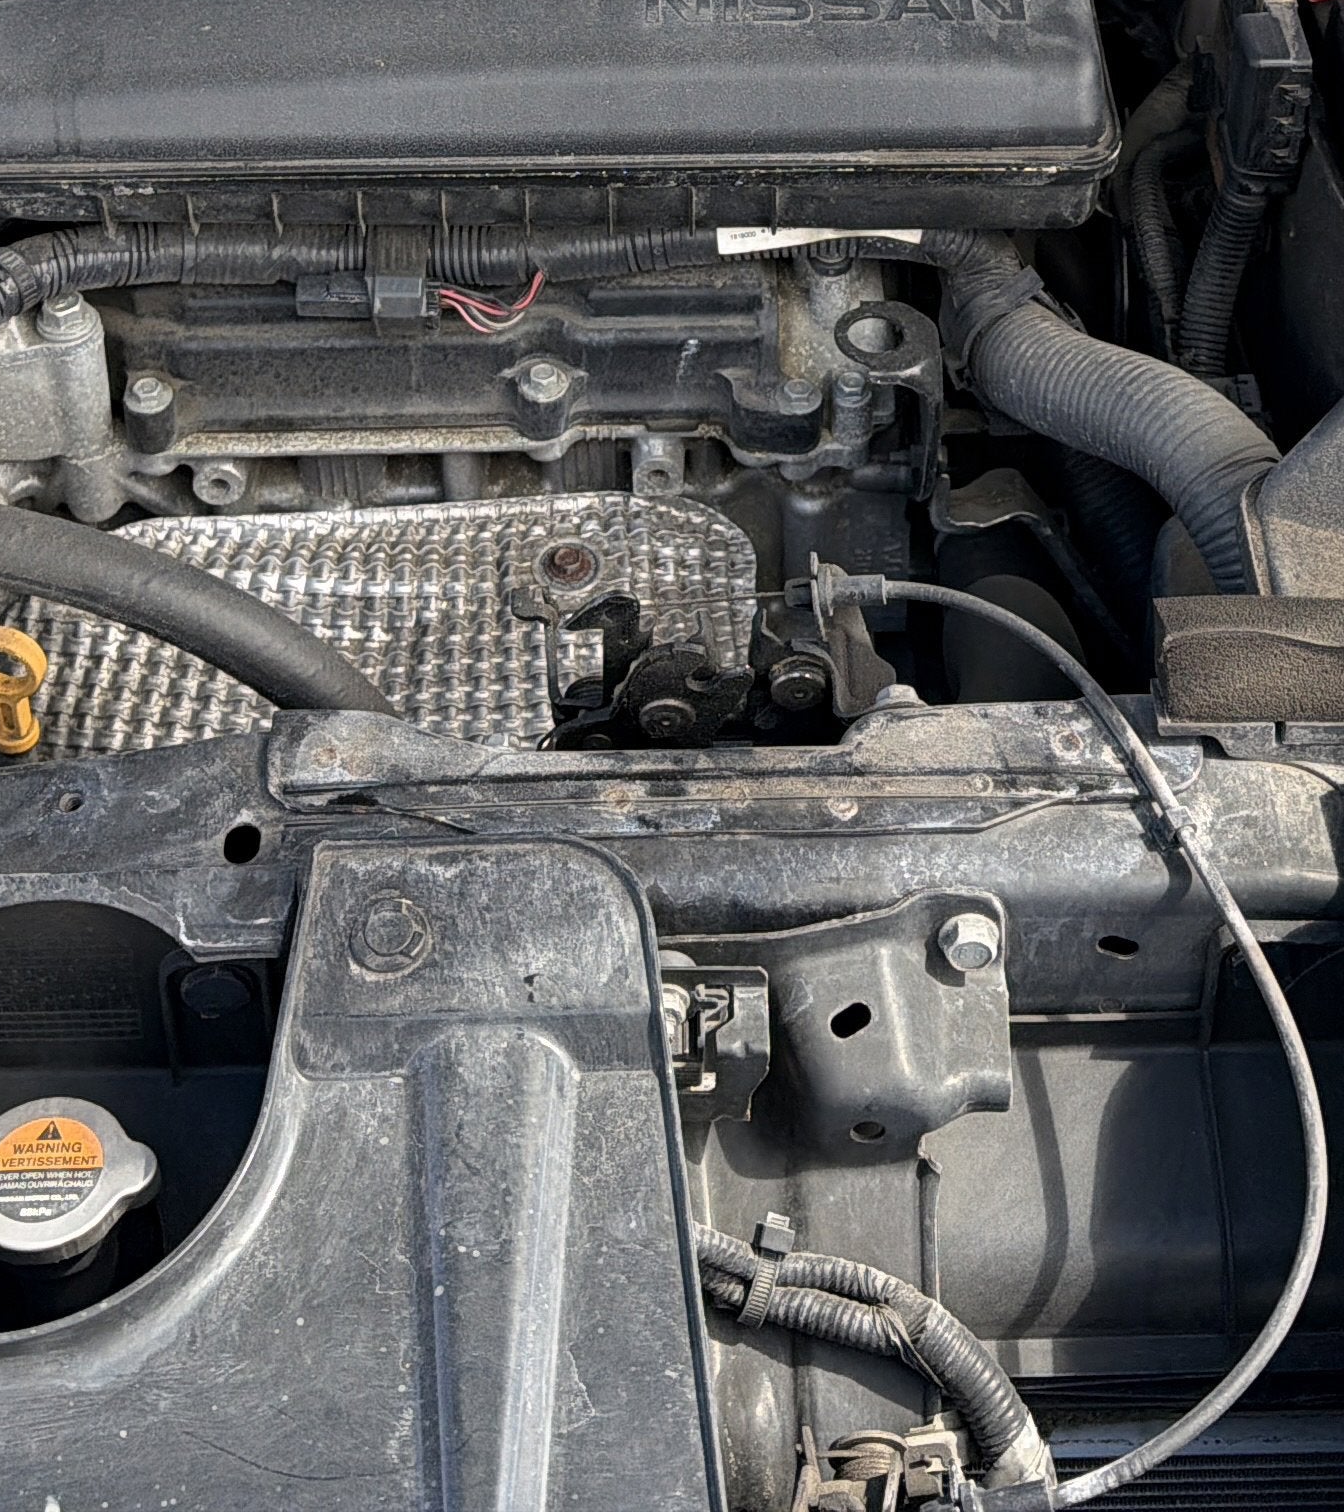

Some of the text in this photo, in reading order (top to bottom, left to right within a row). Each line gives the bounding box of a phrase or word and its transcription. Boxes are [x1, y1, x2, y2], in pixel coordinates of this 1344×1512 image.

[12, 1141, 82, 1155] WARNING
[21, 1171, 45, 1180] OPEN
[46, 1170, 72, 1179] WHEN
[0, 1181, 27, 1190] JAMAIS
